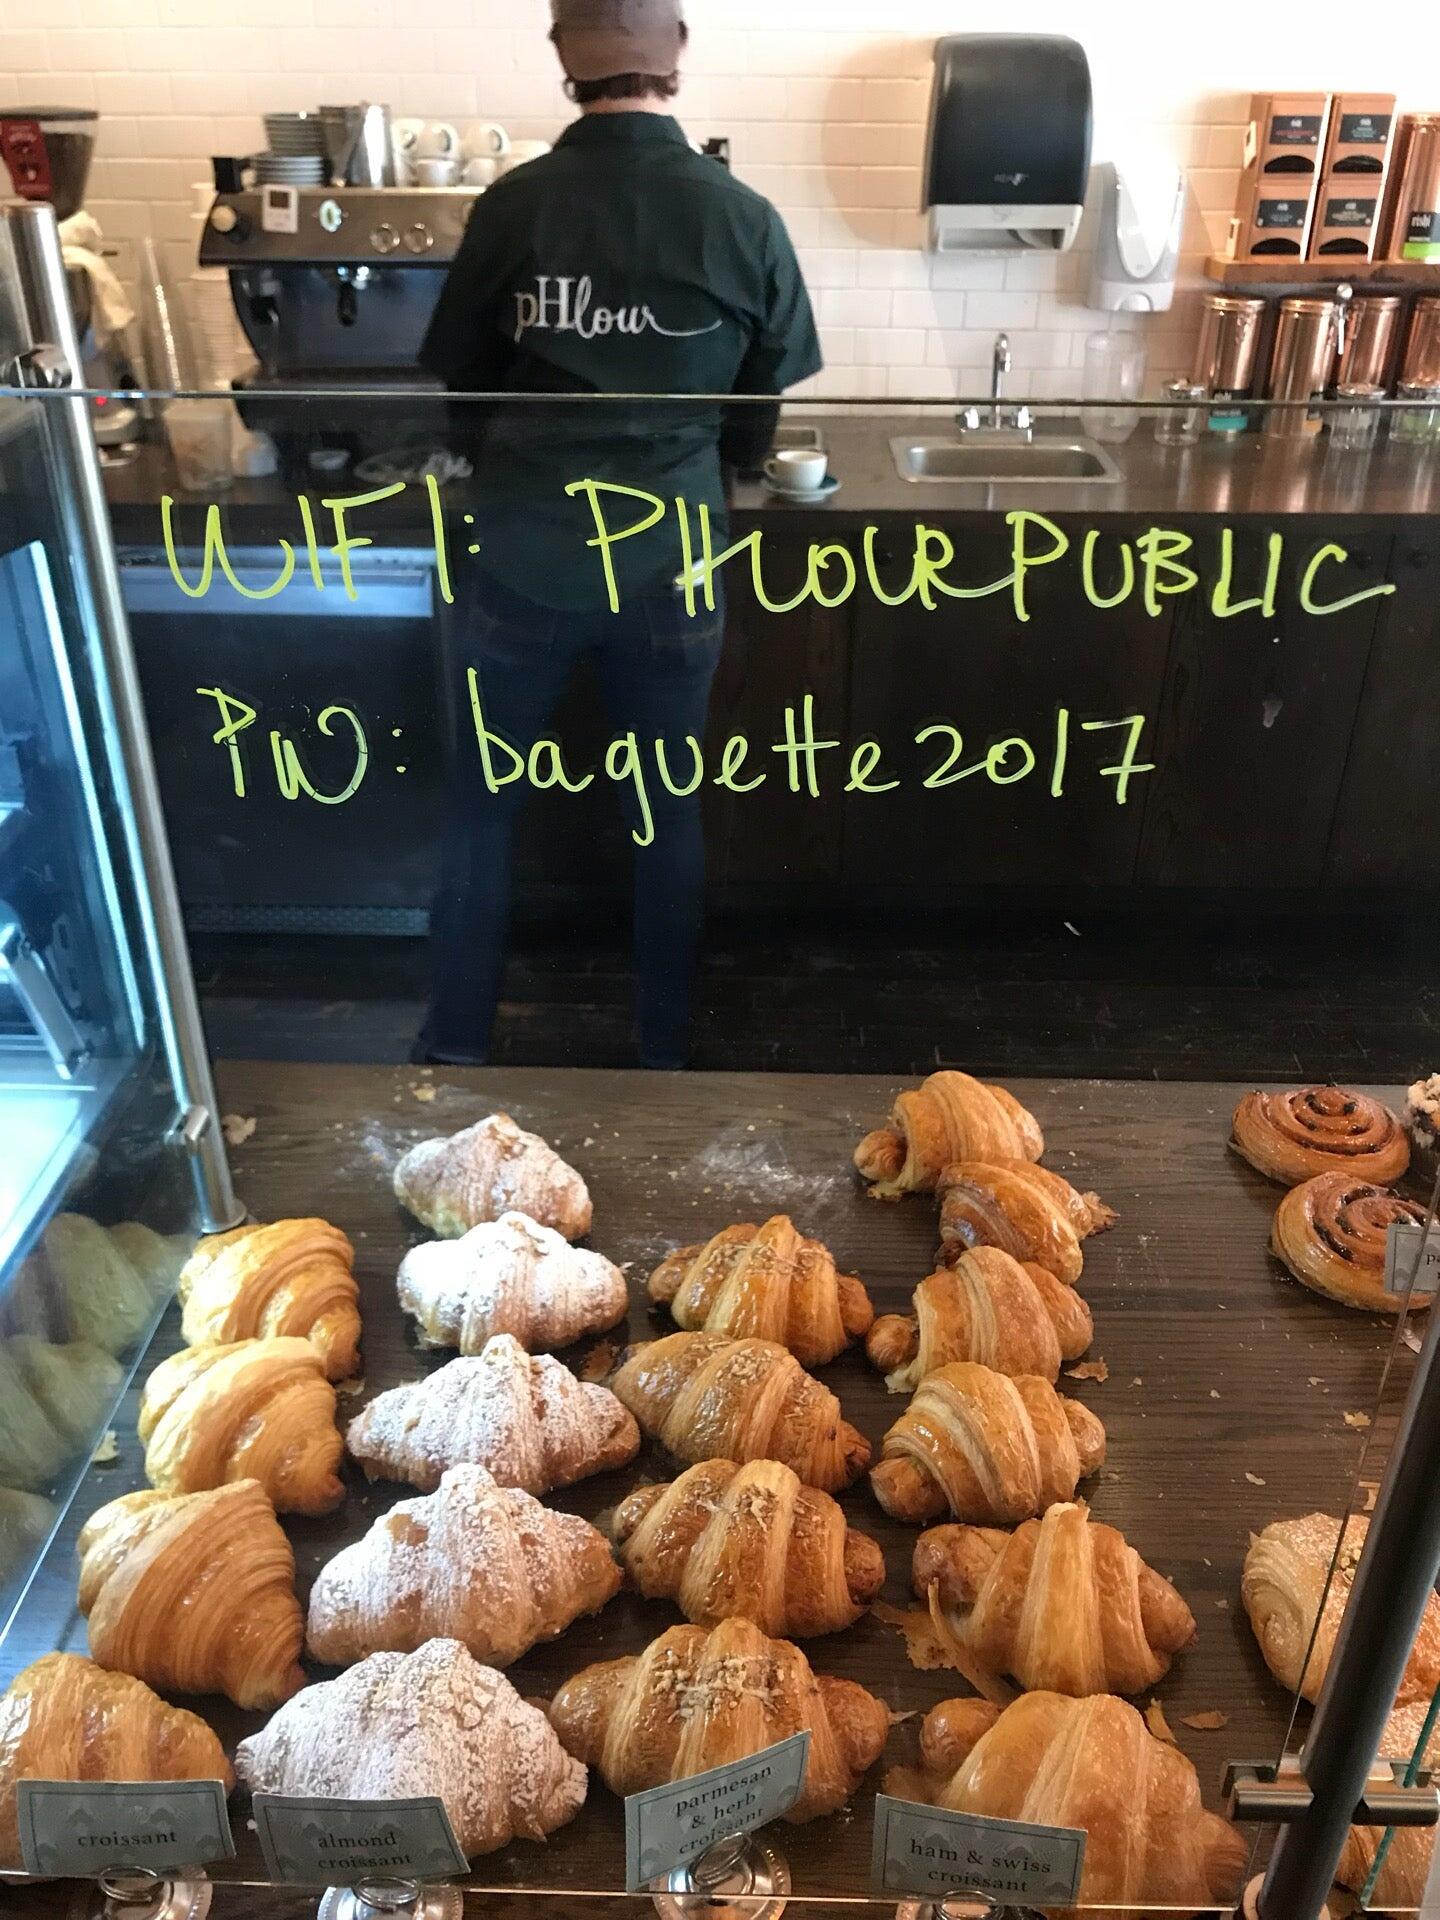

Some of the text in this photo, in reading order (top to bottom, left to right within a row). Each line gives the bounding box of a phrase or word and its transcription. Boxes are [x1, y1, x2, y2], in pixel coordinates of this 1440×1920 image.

[514, 275, 723, 343] pHlour
[161, 473, 481, 604] WIFI:
[466, 667, 1156, 847] baguette2017
[676, 1766, 772, 1817] parmesan
[691, 1792, 756, 1829] & herb
[78, 1831, 178, 1847] croissant
[318, 1831, 397, 1848] almond
[679, 1808, 763, 1854] croissant
[318, 1854, 412, 1869] croissant
[911, 1839, 1051, 1873] ham & swiss
[928, 1871, 1028, 1892] croissant
